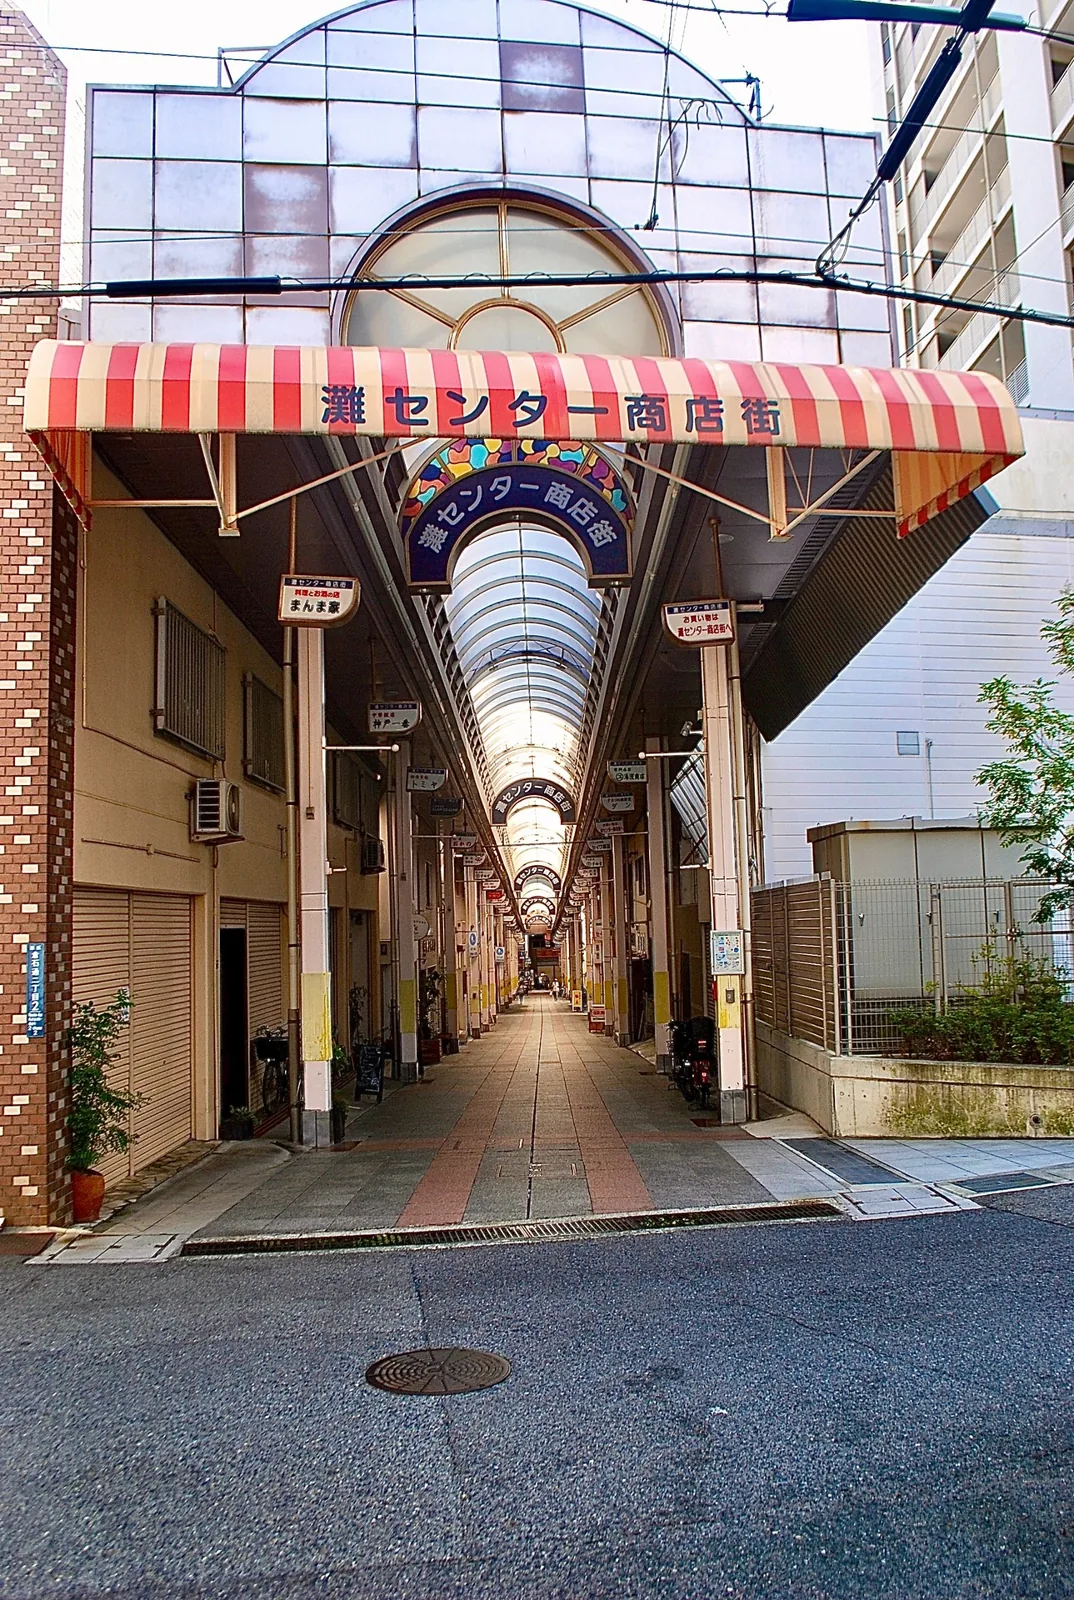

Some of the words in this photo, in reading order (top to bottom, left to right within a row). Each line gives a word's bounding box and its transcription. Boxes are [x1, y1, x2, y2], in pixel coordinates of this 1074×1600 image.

[320, 385, 781, 435] 灘センター商店街
[417, 475, 618, 554] 灘センター商店街
[290, 599, 341, 613] まんま家
[682, 614, 719, 624] お買い物は
[495, 782, 573, 813] 灘センター商店街
